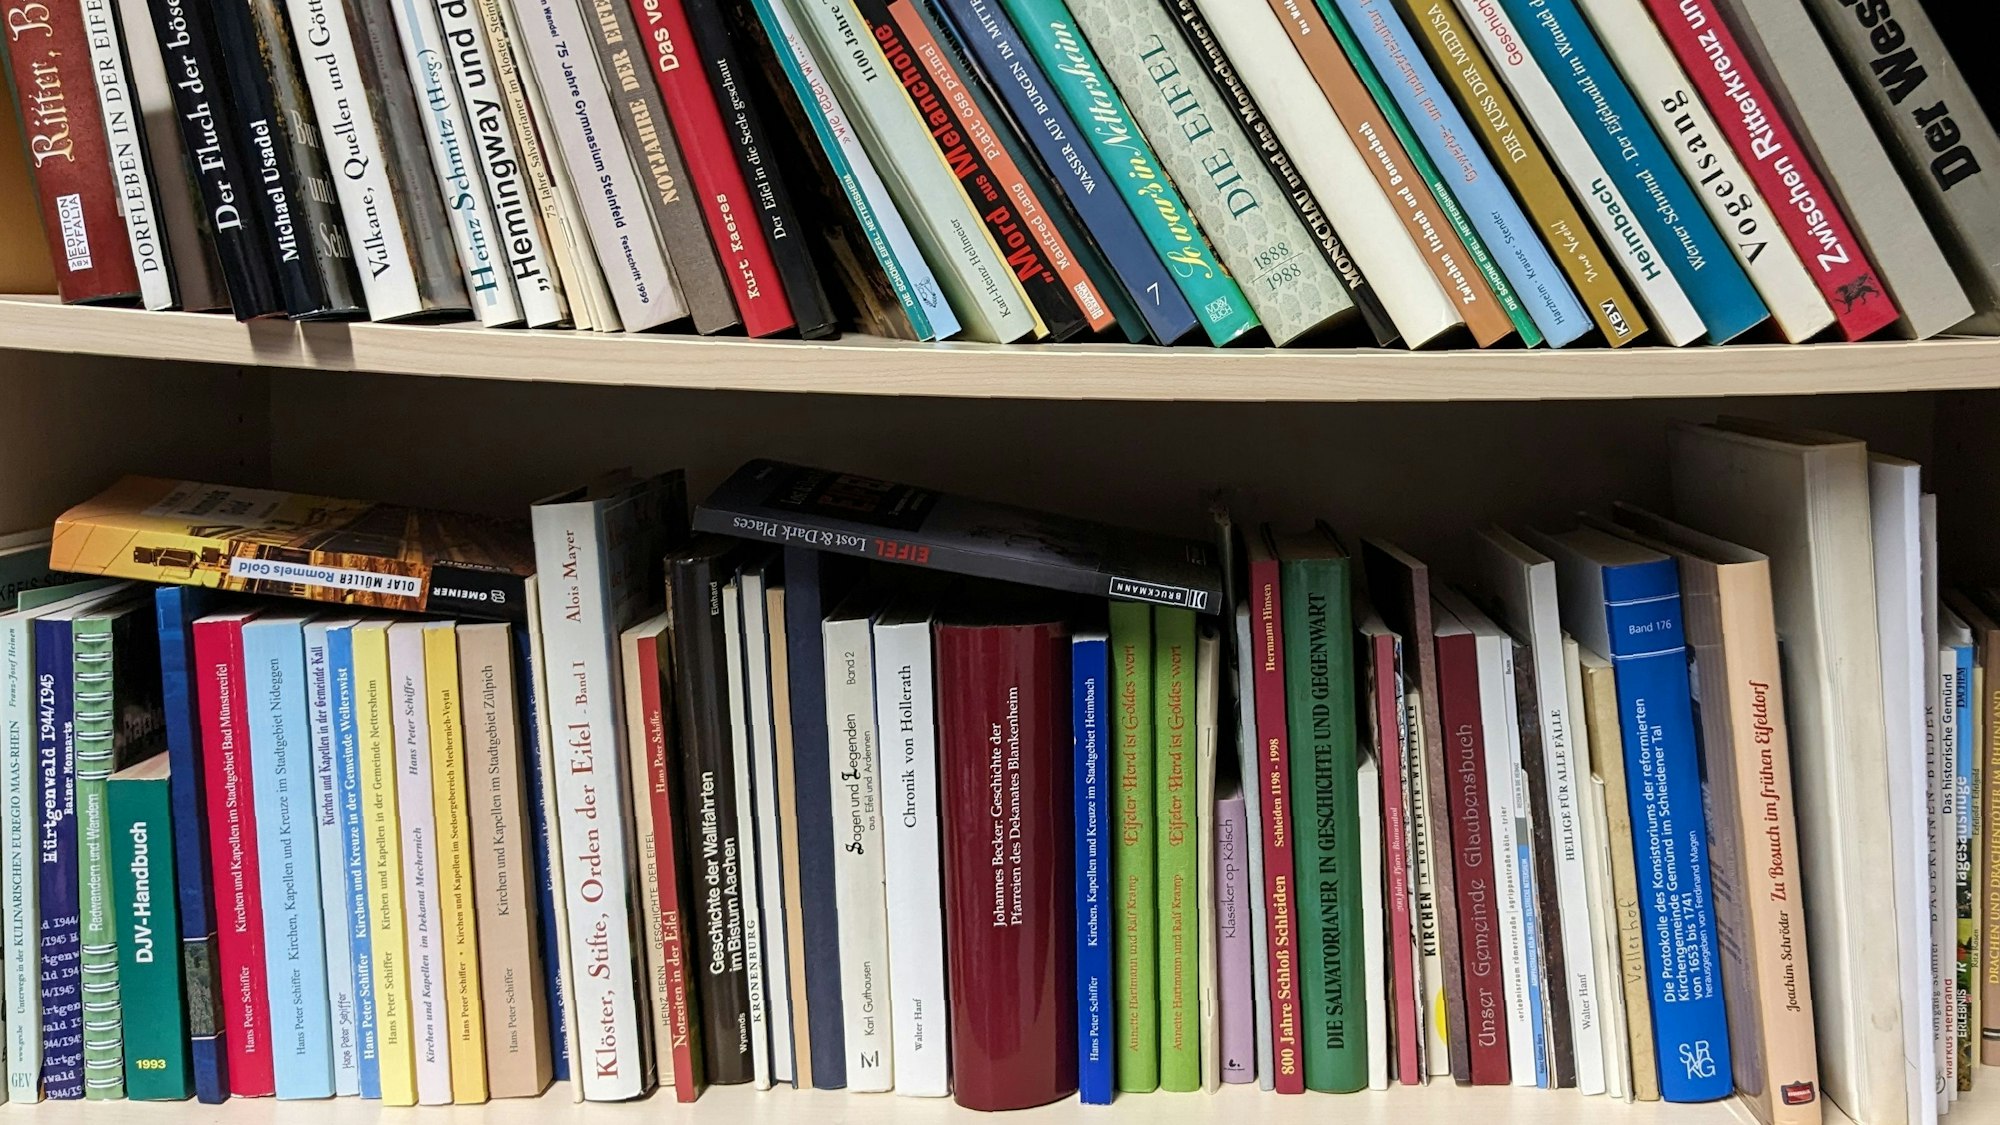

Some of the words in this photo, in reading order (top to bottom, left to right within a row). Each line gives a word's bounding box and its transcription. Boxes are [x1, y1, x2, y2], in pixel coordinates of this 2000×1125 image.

[556, 40, 569, 58] 75
[832, 6, 858, 46] Jahre
[1428, 4, 1470, 66] MEDUSA
[1536, 8, 1573, 57] Wandel
[314, 52, 343, 90] und
[448, 28, 486, 88] und
[654, 28, 680, 72] Das
[852, 50, 878, 82] 1100
[918, 44, 958, 90] prima!
[997, 40, 1014, 60] IM
[1190, 22, 1260, 124] Monschauer
[1570, 56, 1586, 76] im
[98, 58, 122, 102] DER
[178, 54, 204, 94] der
[416, 50, 450, 112] (Hrsg.)
[562, 62, 580, 96] Jahre
[716, 58, 746, 110] geschaut
[1010, 62, 1048, 116] BURGEN
[1050, 22, 1141, 156] Nettersheim
[1140, 34, 1214, 144] EIFEL
[1462, 64, 1488, 97] DER
[1698, 28, 1782, 160] Ritterkreuz
[28, 50, 74, 168] Ritter,
[110, 112, 128, 134] IN
[734, 112, 754, 144] Seele
[954, 92, 974, 118] öss
[1480, 96, 1508, 132] KUSS
[1576, 76, 1622, 134] Eifelwald
[186, 102, 226, 174] Fluch
[250, 118, 280, 184] Usadel
[332, 98, 370, 180] Quellen
[576, 100, 604, 172] Gymnasium
[970, 120, 1000, 160] Platt
[1044, 118, 1066, 140] AUF
[1254, 122, 1278, 152] das
[1502, 129, 1526, 164] DER
[1616, 136, 1638, 161] Der
[1912, 100, 1982, 192] Der
[440, 118, 476, 210] Schmitz
[746, 146, 760, 164] die
[754, 166, 766, 180] in
[1062, 142, 1096, 194] WASSER
[1128, 154, 1156, 180] in
[1270, 152, 1300, 188] und
[1358, 122, 1402, 186] Bonnesbach
[1660, 82, 1768, 268] Vogelsang
[216, 180, 242, 234] Der
[472, 100, 550, 292] „Hemingway
[600, 174, 626, 228] Steinfeld
[758, 182, 776, 210] Eifel
[976, 174, 998, 202] aus
[1202, 148, 1259, 220] DIE
[1398, 186, 1416, 208] und
[1636, 170, 1678, 224] Schwind
[116, 144, 158, 273] DORFLEBEN
[266, 186, 300, 262] Michael
[716, 194, 744, 252] Kaeres
[772, 216, 786, 240] Der
[1412, 210, 1444, 252] Itzbach
[1592, 178, 1661, 282] Heimbach
[1774, 156, 1849, 272] Zwischen
[362, 188, 390, 280] Vulkane,
[468, 218, 498, 292] Heinz
[1253, 241, 1289, 271] 1888
[1292, 190, 1364, 290] MONSCHAU
[1672, 226, 1706, 270] Werner
[620, 236, 642, 280] Festschrift
[740, 258, 760, 300] Kurt
[1265, 263, 1303, 291] 1988
[1442, 254, 1476, 304] Zwischen
[636, 282, 649, 302] 1999
[1602, 302, 1628, 336] KBV
[734, 518, 778, 537] Places
[782, 526, 818, 544] Dark
[820, 532, 833, 545] &
[836, 534, 866, 551] Lost
[876, 540, 930, 562] EIFEL
[238, 562, 270, 574] Gold
[274, 566, 334, 582] Rommels
[562, 530, 582, 578] Mayer
[340, 574, 382, 588] MÜLLER
[386, 578, 414, 591] OLAF
[432, 586, 488, 600] GMEINER
[566, 586, 582, 623] Alois
[1308, 592, 1329, 699] GEGENWART
[1629, 622, 1653, 635] Band
[1656, 620, 1672, 630] 176
[216, 664, 231, 726] Münstereifel
[574, 672, 588, 704] Band
[898, 665, 912, 732] Hollerath
[990, 722, 1001, 744] der
[1006, 687, 1019, 769] Blankenheim
[1312, 704, 1331, 739] UND
[1650, 726, 1662, 742] Tal
[1748, 680, 1774, 744] Eifeldorf
[220, 729, 232, 748] Bad
[568, 722, 594, 775] Eifel
[904, 738, 914, 763] von
[1636, 698, 1652, 776] reformierten
[224, 752, 238, 807] Stadtgebiet
[990, 748, 1002, 816] Geschichte
[1314, 744, 1336, 850] GESCHICHTE
[1456, 724, 1482, 866] Glaubensbuch
[1642, 780, 1654, 800] der
[1654, 746, 1670, 815] Schleidener
[1760, 748, 1780, 800] frühen
[42, 747, 63, 863] Hürtgenwald
[574, 784, 596, 820] der
[700, 772, 718, 858] Wallfahrten
[902, 770, 916, 827] Chronik
[1008, 773, 1020, 838] Dekanates
[1764, 802, 1777, 821] im
[228, 824, 244, 868] Kapellen
[992, 820, 1004, 865] Becker:
[1646, 804, 1664, 887] Konsistoriums
[1660, 820, 1672, 835] im
[578, 828, 604, 902] Orden
[704, 860, 719, 885] der
[1010, 842, 1021, 863] des
[1318, 856, 1336, 874] IN
[1662, 838, 1678, 890] Gemünd
[1766, 826, 1784, 878] Besuch
[130, 822, 153, 962] DJV-Handbuch
[234, 892, 246, 932] Kirchen
[992, 868, 1007, 926] Johannes
[1010, 867, 1022, 925] Pfarreien
[1272, 876, 1288, 946] Schleiden
[1654, 892, 1666, 912] des
[1770, 882, 1786, 902] Zu
[586, 914, 610, 980] Stifte,
[706, 887, 725, 974] Geschichte
[1320, 880, 1343, 1014] SALVATORIANER
[1468, 878, 1491, 976] Gemeinde
[1656, 916, 1673, 978] Protokolle
[1668, 894, 1690, 1001] Kirchengemeinde
[1778, 910, 1792, 960] Schröder
[1276, 950, 1291, 999] Schloß
[1664, 982, 1676, 1002] Die
[1784, 964, 1800, 1012] Joachim
[596, 990, 618, 1078] Klöster,
[1280, 1003, 1294, 1044] Jahre
[1326, 1020, 1344, 1048] DIE
[1478, 988, 1496, 1046] Unser
[136, 1059, 166, 1069] 1993
[1280, 1048, 1294, 1074] 800
